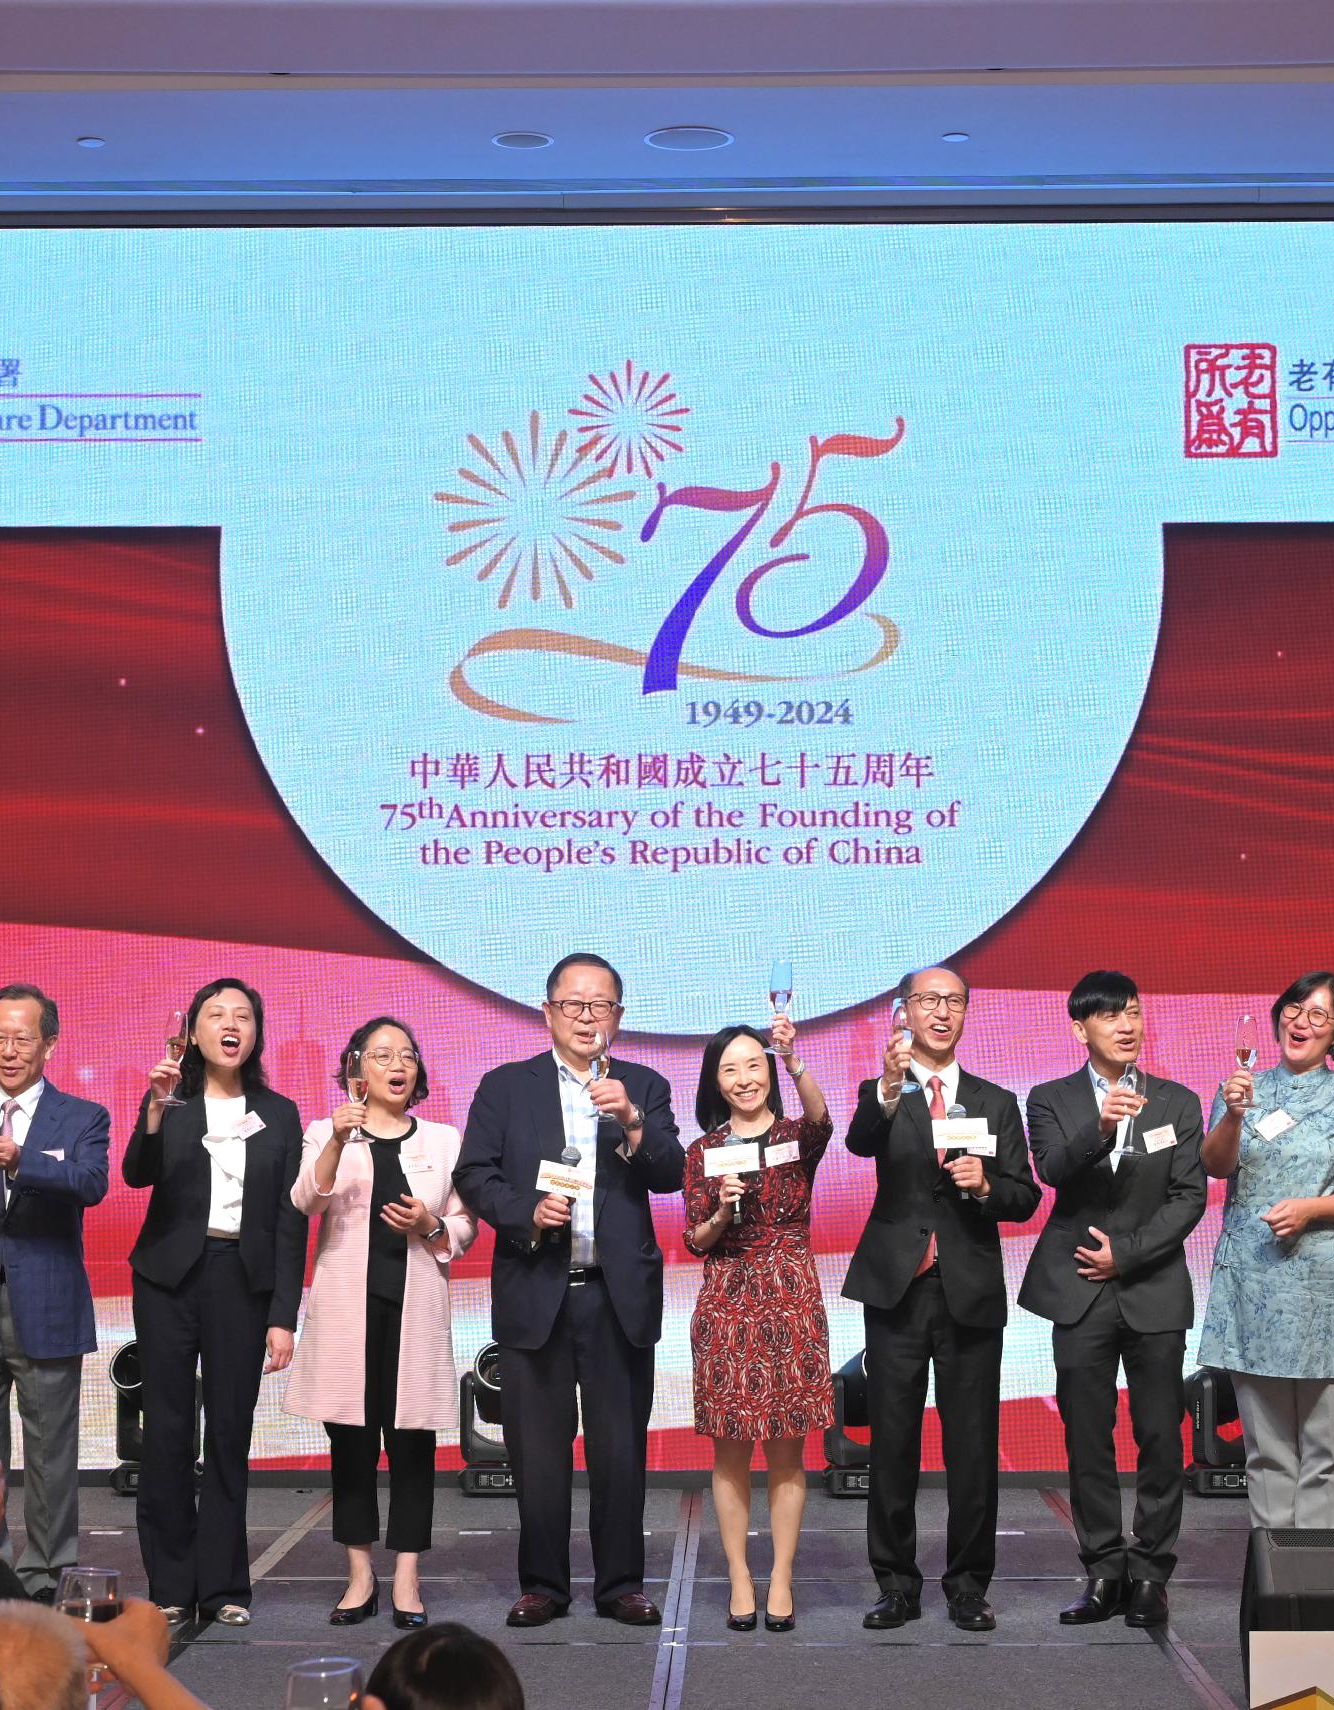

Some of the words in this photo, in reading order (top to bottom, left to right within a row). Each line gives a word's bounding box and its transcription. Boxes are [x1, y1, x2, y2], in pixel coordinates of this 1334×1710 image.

[39, 404, 198, 437] Department
[640, 415, 905, 696] 75
[686, 699, 854, 727] 1949-2024
[409, 752, 935, 790] 中華人民共和國成立七十五周年
[649, 801, 684, 828] of
[693, 801, 745, 828] the
[759, 801, 914, 835] Founding
[925, 800, 962, 828] of
[419, 838, 471, 865] the
[629, 839, 771, 872] Republic
[782, 838, 818, 865] of
[828, 838, 923, 865] China
